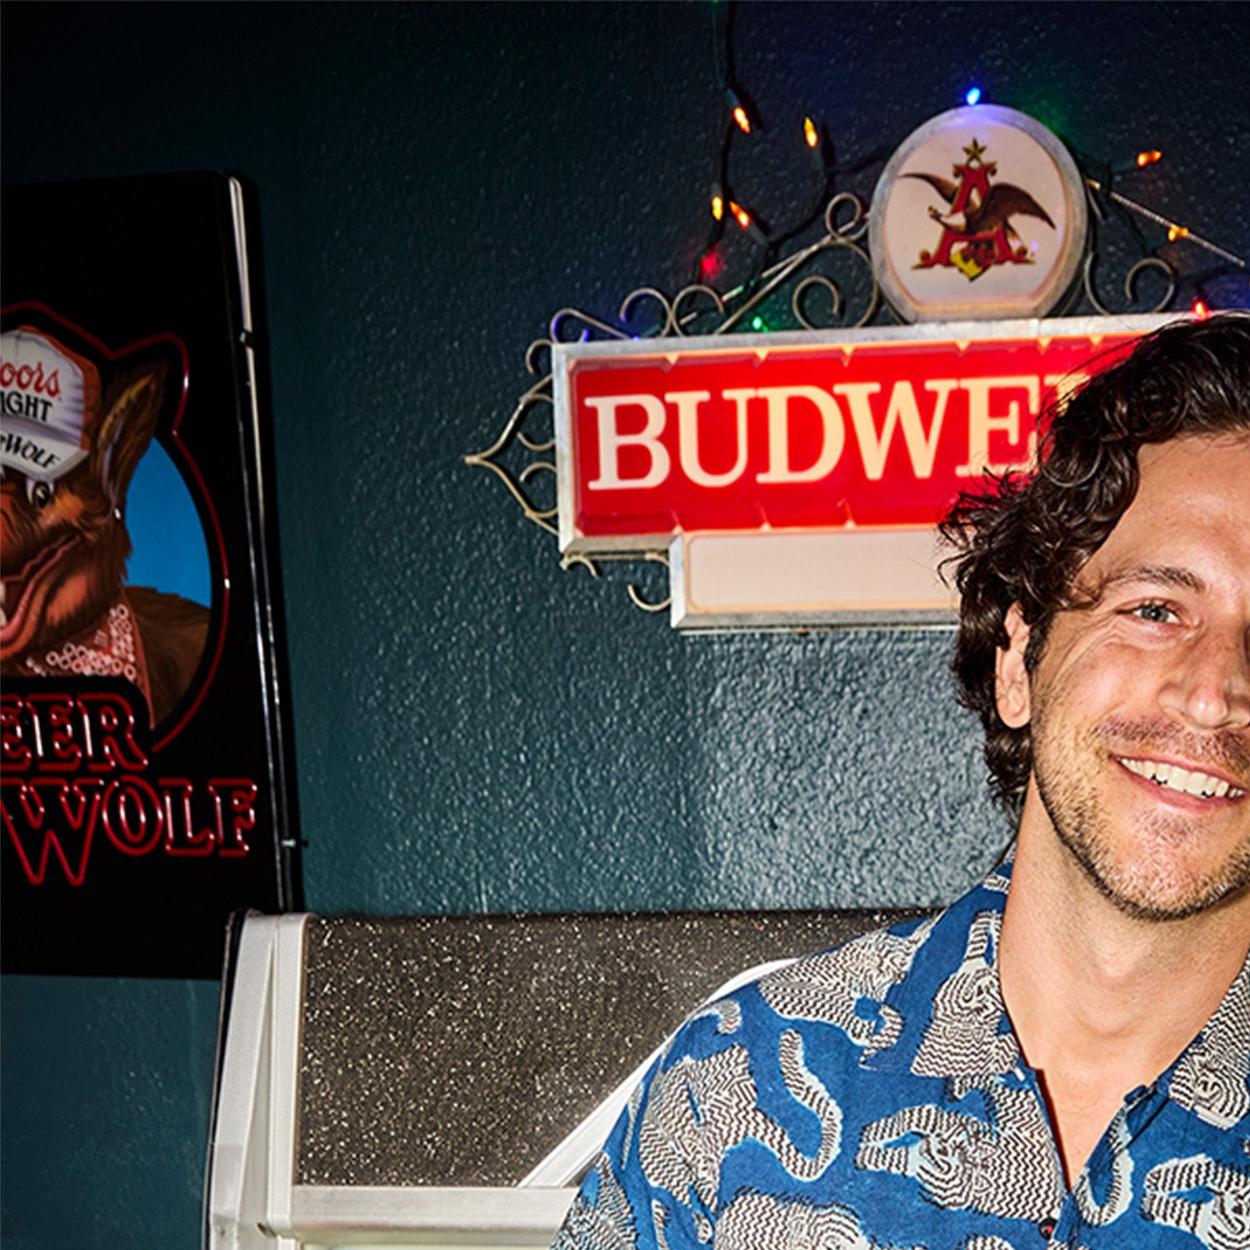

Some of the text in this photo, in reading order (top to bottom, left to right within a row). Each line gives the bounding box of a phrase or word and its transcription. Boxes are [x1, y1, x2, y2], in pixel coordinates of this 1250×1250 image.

[0, 359, 62, 398] oors
[0, 391, 53, 422] IGHT
[0, 432, 60, 468] WOLF
[0, 774, 257, 887] WOLF
